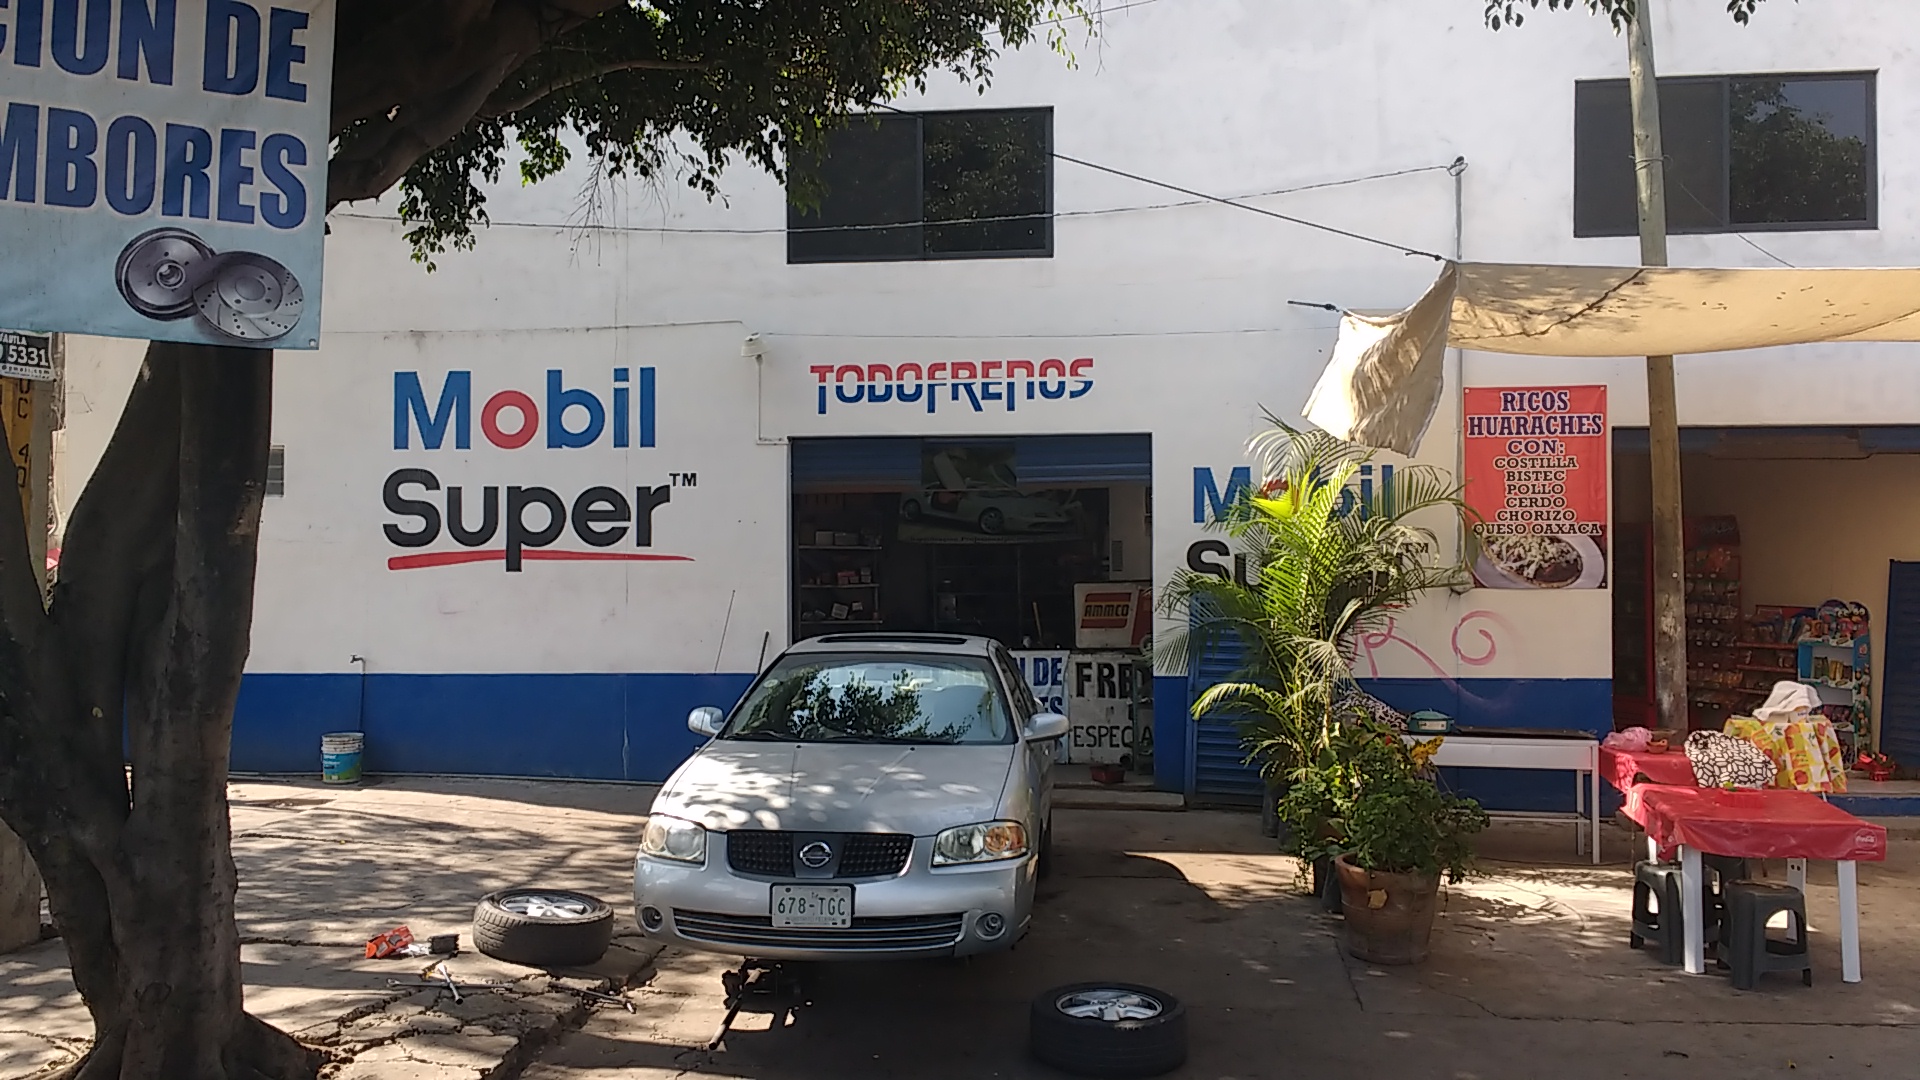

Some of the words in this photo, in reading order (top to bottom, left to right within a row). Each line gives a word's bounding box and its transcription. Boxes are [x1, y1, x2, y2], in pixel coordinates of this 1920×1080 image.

[202, 0, 309, 103] DE
[809, 358, 1094, 415] TODOFRENOS
[393, 367, 656, 450] Mobil
[1501, 391, 1569, 412] RICOS
[1467, 415, 1602, 436] HUARACHES
[1507, 440, 1565, 455] CON:
[1494, 457, 1578, 469] COSTILLA
[1505, 470, 1565, 482] BISTEC
[1506, 484, 1564, 495] POLLO
[1505, 497, 1566, 509] CERDO
[382, 468, 671, 573] Super
[1496, 510, 1576, 522] CHORIZO
[1531, 523, 1602, 535] OAXACA
[1084, 604, 1130, 618] AMMCO
[1033, 657, 1063, 687] DE
[778, 897, 846, 916] 678-TGC
